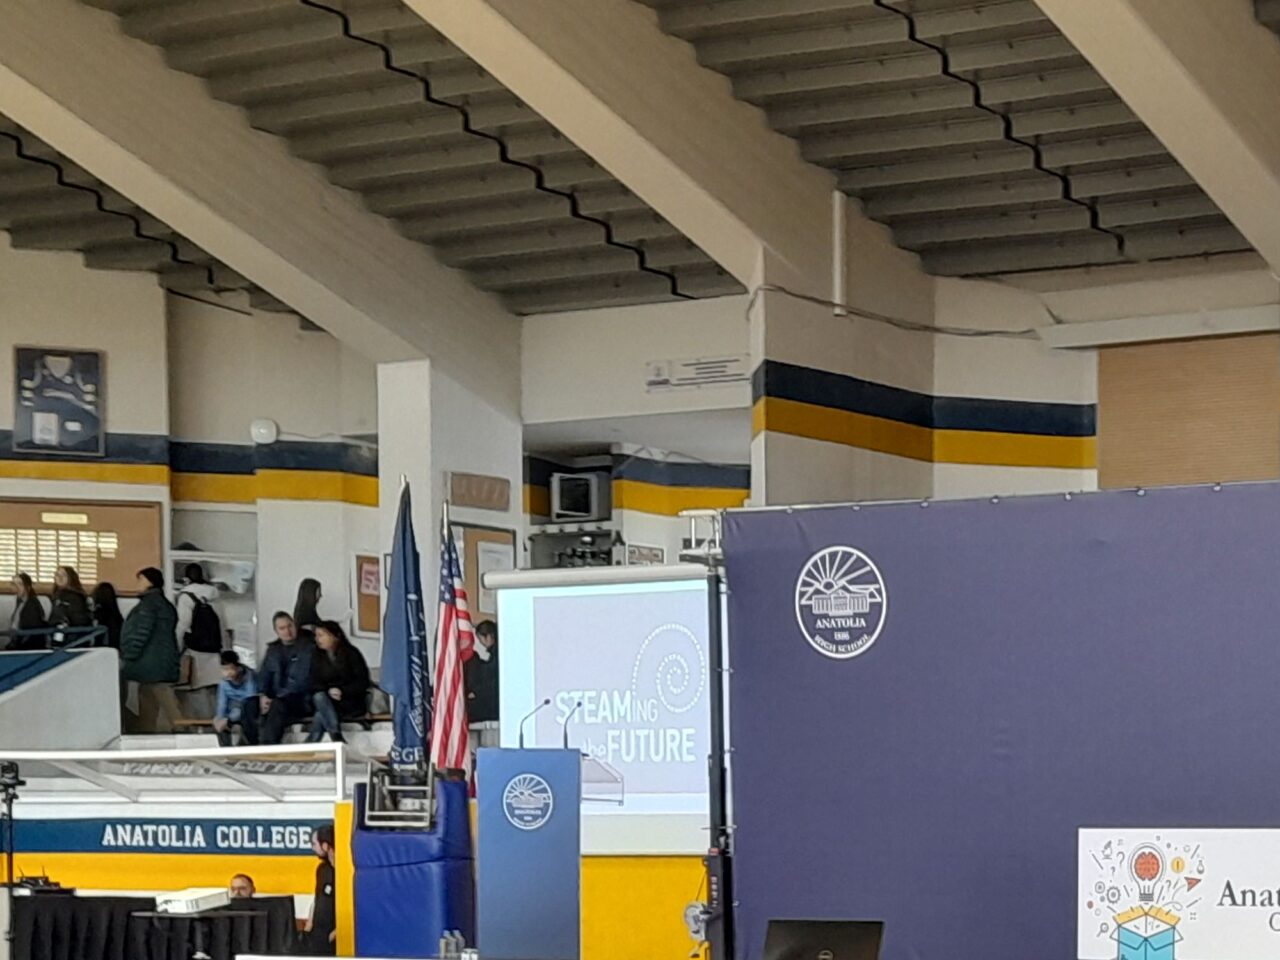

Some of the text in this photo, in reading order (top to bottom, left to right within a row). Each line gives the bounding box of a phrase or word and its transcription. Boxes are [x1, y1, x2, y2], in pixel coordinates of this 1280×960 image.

[815, 617, 866, 629] ANATOLIA
[838, 634, 870, 652] SCHOOL
[101, 825, 312, 849] ANATOLIA COLLEGE
